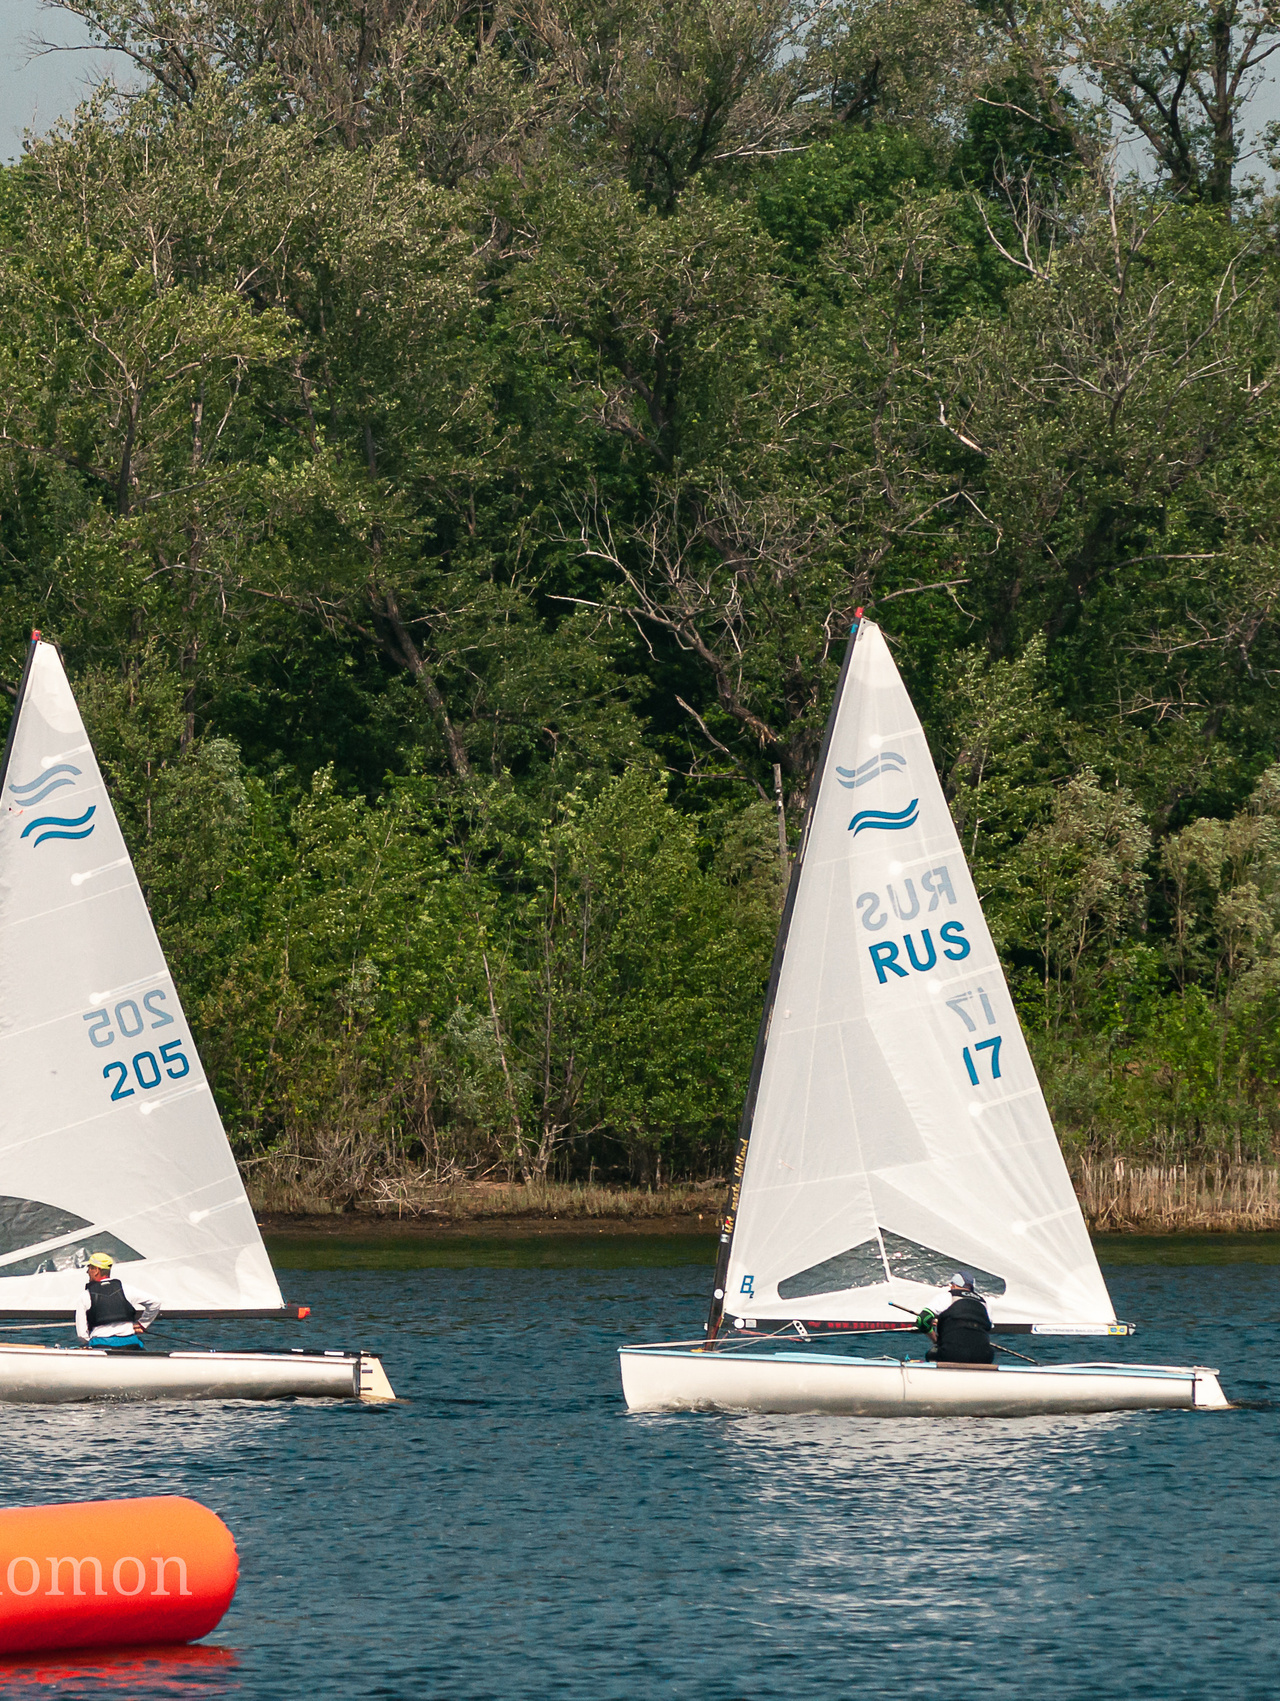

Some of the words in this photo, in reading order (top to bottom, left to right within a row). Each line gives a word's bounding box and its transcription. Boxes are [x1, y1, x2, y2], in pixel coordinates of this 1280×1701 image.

[868, 920, 971, 984] RUS
[102, 1038, 190, 1102] 205
[962, 1035, 1002, 1087] 17
[733, 1136, 749, 1178] Holland
